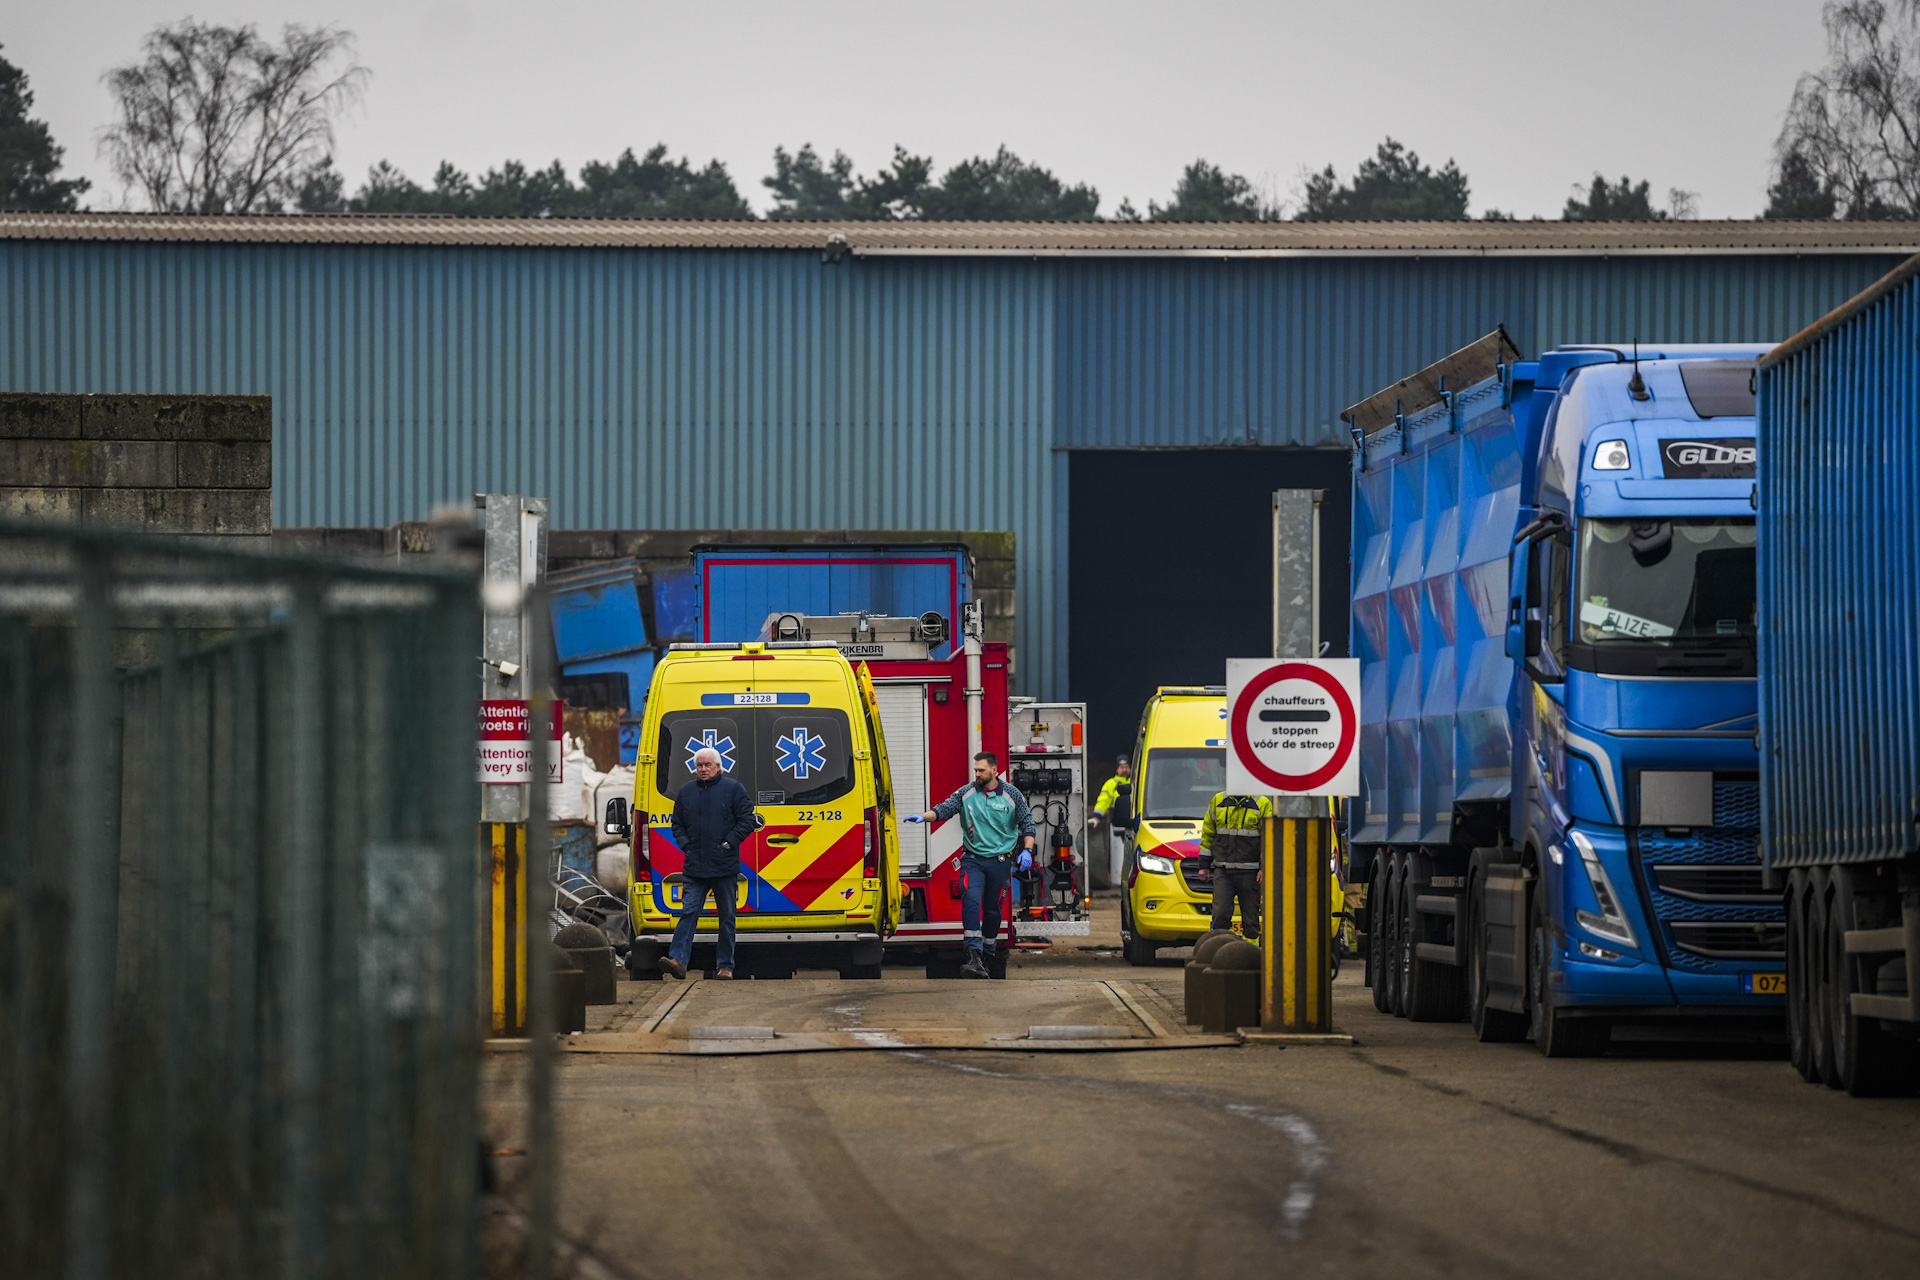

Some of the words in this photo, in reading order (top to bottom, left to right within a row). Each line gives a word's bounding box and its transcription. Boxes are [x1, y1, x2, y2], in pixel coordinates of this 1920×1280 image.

[849, 645, 883, 654] KENBRI
[740, 695, 772, 703] 22-128
[1264, 695, 1326, 706] chauffeurs
[478, 706, 529, 718] Attentie
[476, 720, 515, 732] voets
[517, 719, 554, 733] rijn
[1271, 726, 1318, 737] stoppen
[1253, 739, 1279, 749] vóór
[1282, 739, 1297, 749] de
[1300, 740, 1335, 751] streep
[475, 748, 534, 759] Attention
[484, 764, 513, 775] very
[516, 762, 557, 775] sloy
[798, 810, 842, 821] 22-128
